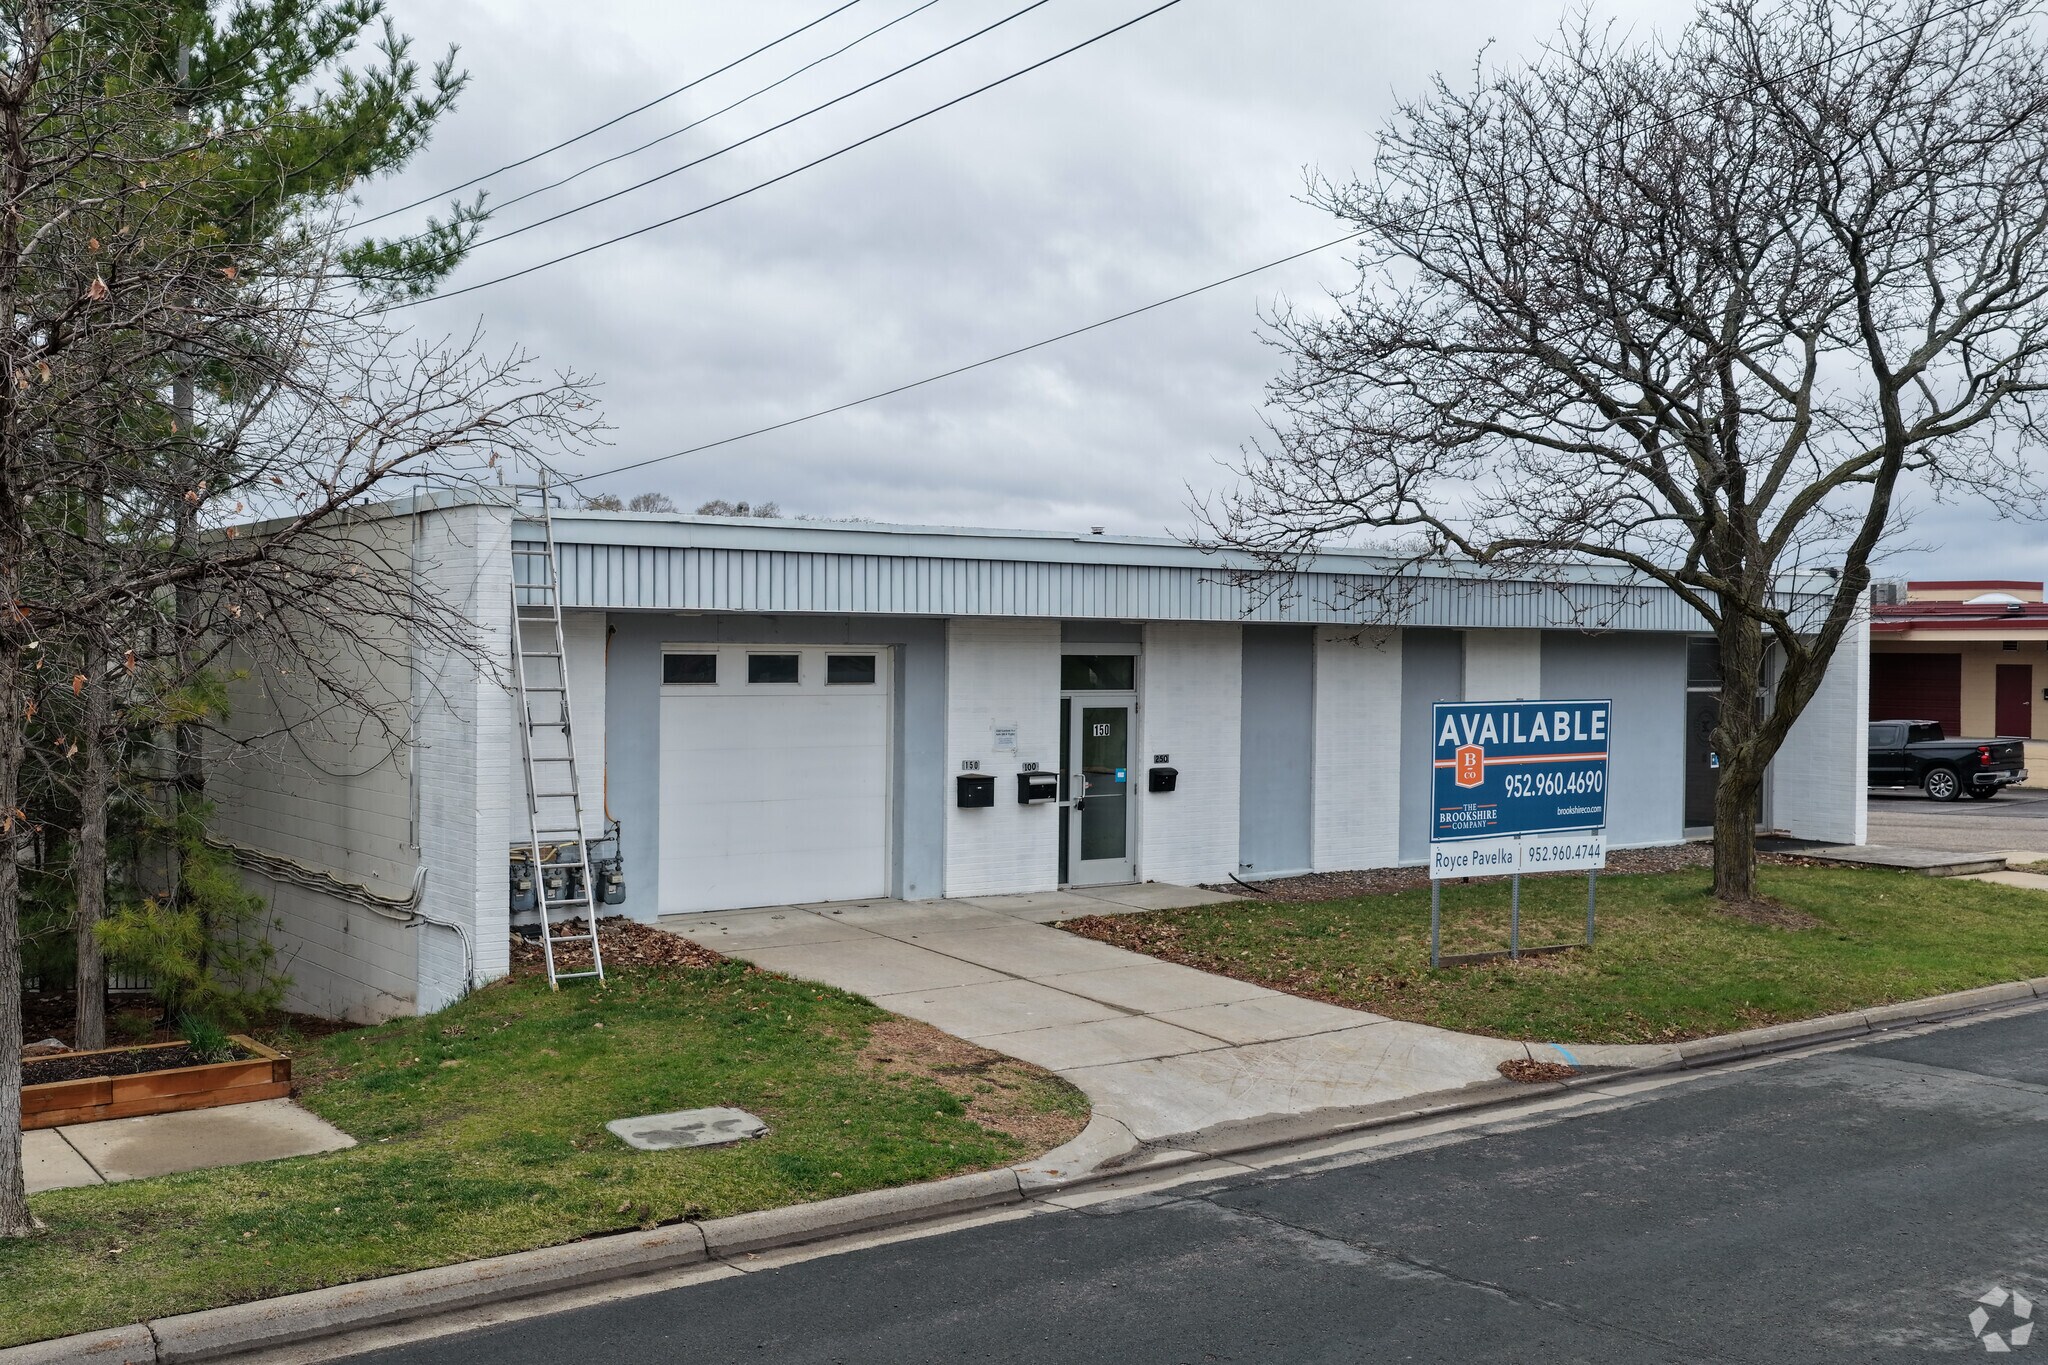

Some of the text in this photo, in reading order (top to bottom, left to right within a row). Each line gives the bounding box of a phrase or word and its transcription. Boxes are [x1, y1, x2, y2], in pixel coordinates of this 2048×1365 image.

[1094, 724, 1109, 736] 150
[1438, 710, 1606, 746] AVAILABLE
[1155, 754, 1168, 763] 250
[1464, 752, 1477, 767] B
[965, 760, 979, 770] 150
[1024, 762, 1037, 772] 100
[1464, 771, 1477, 779] CO
[1505, 770, 1603, 798] 952.960.4690
[1463, 803, 1477, 811] THE
[1557, 805, 1602, 816] brookshireco.com
[1440, 809, 1498, 823] BROOKSHIRE
[1452, 820, 1487, 830] COMPANY
[1529, 844, 1601, 862] 952.960.4744
[1436, 848, 1513, 871] Royce Pavelka
